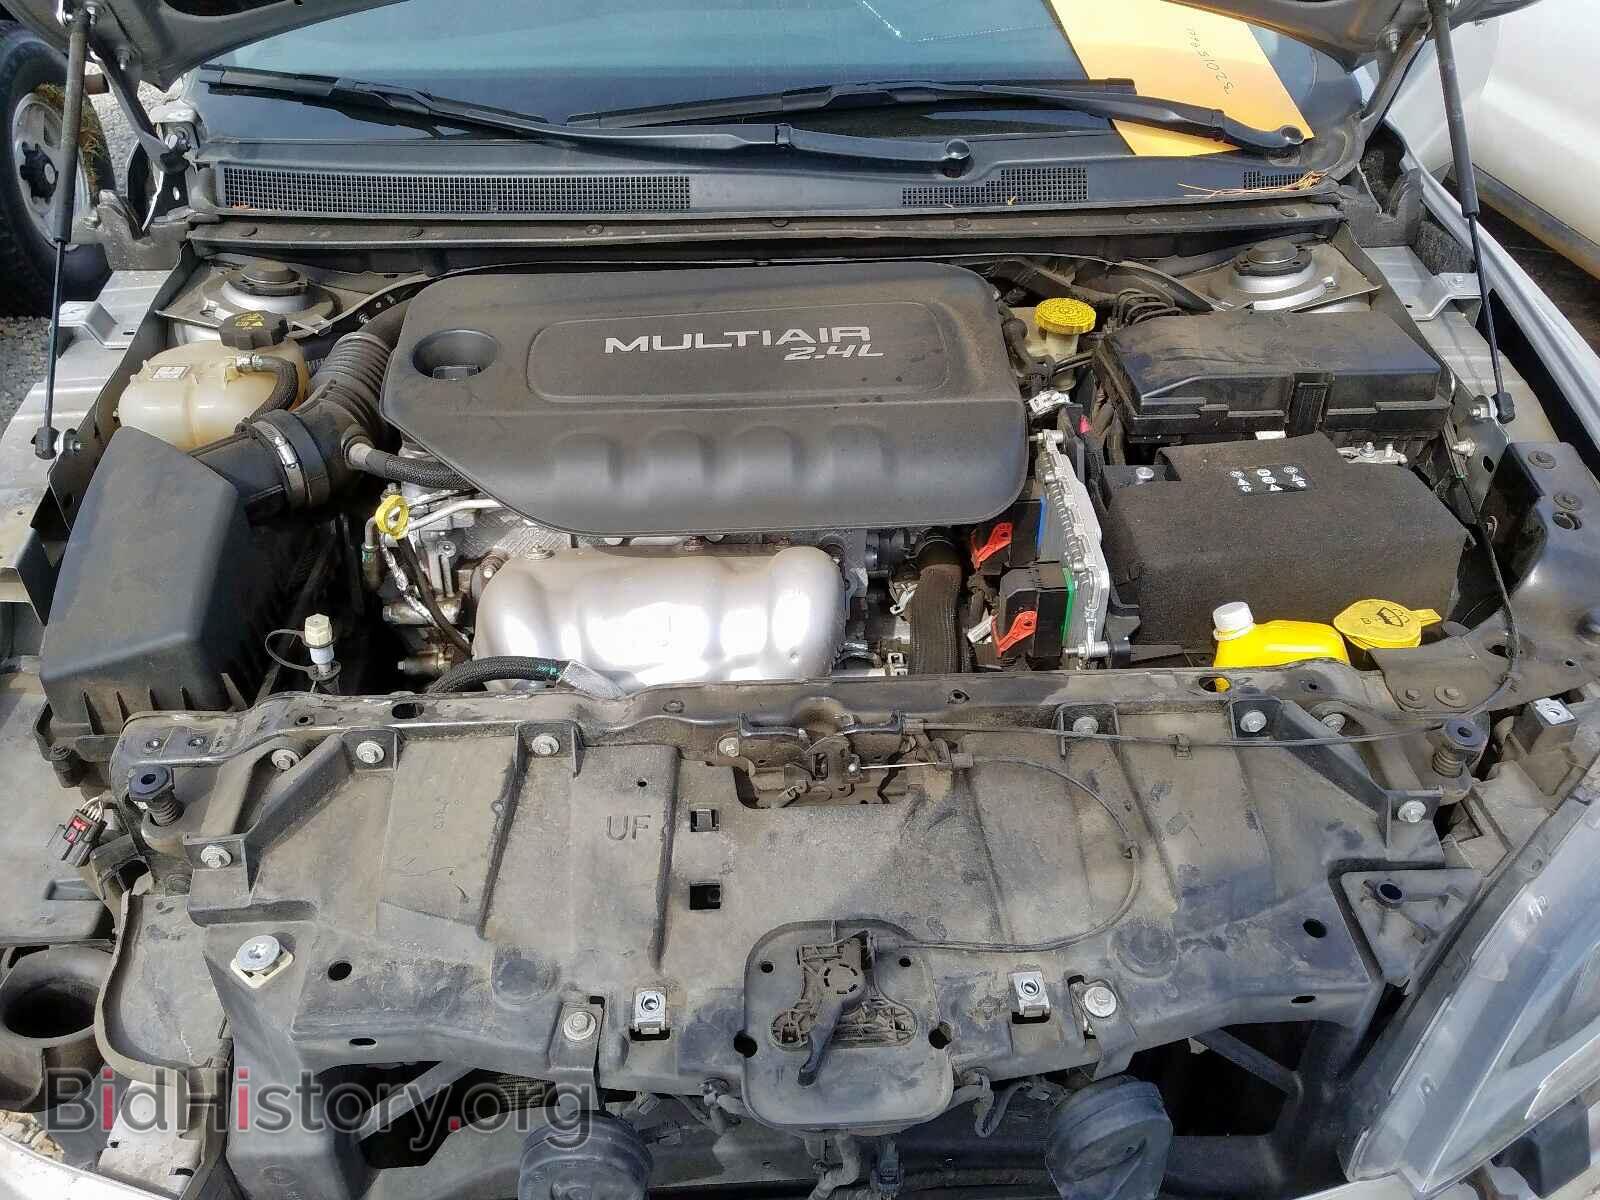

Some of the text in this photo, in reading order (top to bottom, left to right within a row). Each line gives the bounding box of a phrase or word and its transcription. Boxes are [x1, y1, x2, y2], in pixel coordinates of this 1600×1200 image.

[604, 326, 872, 354] MULTIAIR
[783, 343, 885, 361] 2.4L
[606, 814, 652, 841] UF
